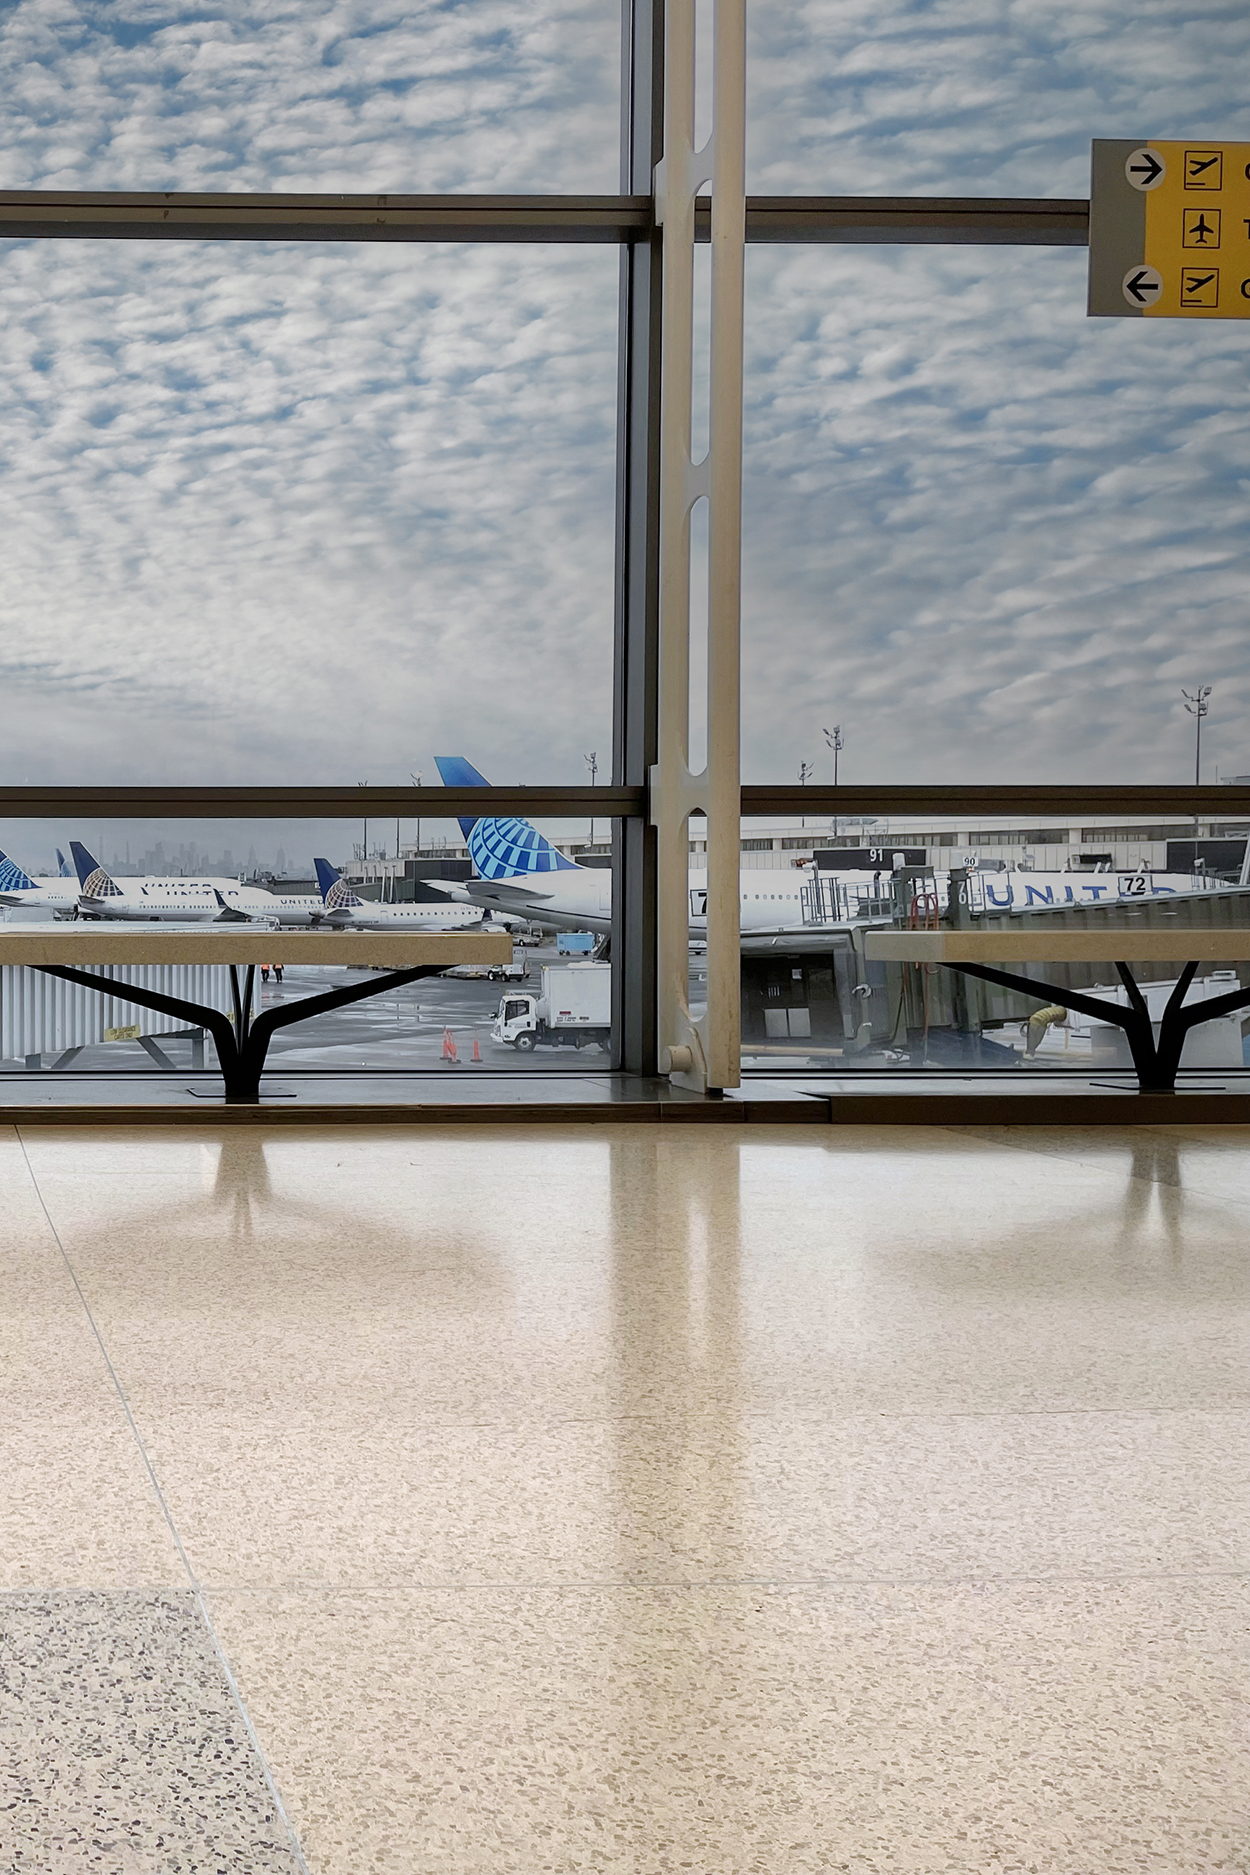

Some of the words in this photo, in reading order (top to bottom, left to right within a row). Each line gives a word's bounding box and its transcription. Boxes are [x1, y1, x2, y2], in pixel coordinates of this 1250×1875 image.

[869, 849, 884, 862] 91
[964, 857, 976, 867] 90
[1124, 877, 1146, 892] 72
[986, 883, 1178, 907] UNIT
